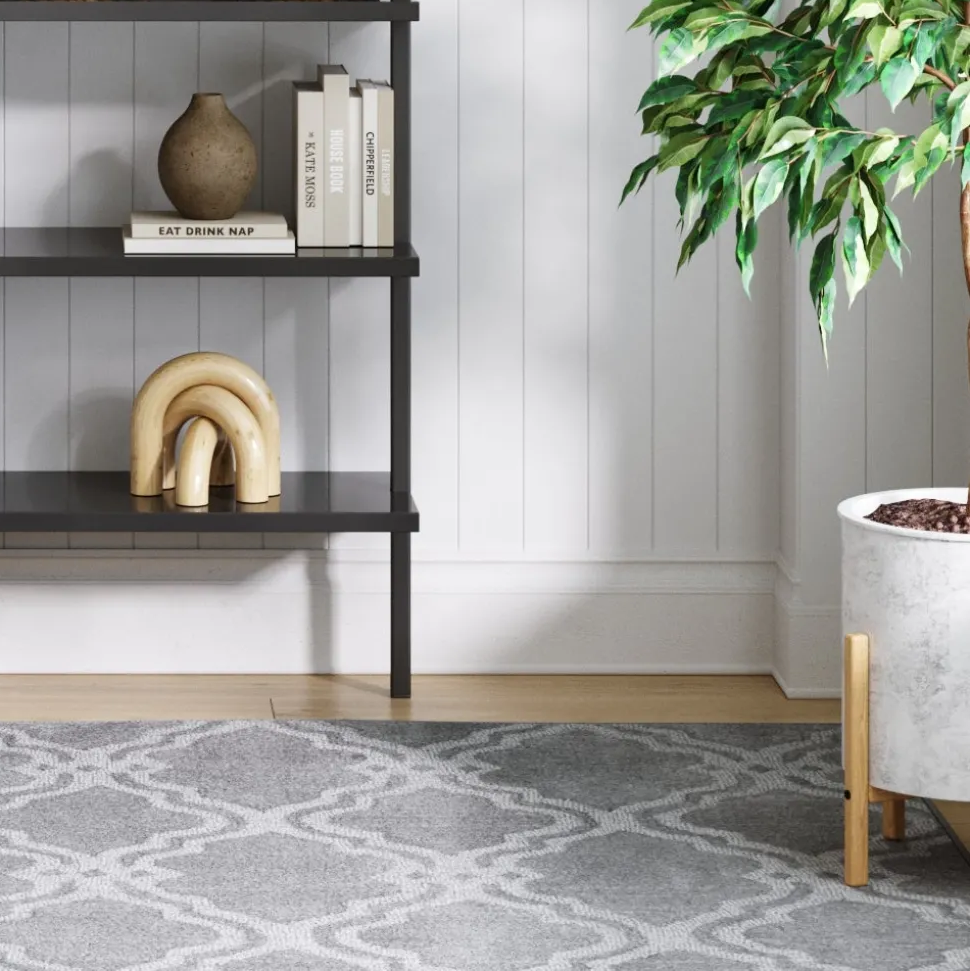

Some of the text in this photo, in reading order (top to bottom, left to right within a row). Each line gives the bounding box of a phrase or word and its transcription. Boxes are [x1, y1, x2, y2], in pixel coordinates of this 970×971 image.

[305, 142, 315, 173] KATE
[330, 130, 344, 193] HOUSE BOOK
[366, 132, 374, 196] CHIPPERFIELD
[305, 177, 315, 208] MOSS
[159, 227, 254, 236] EAT DRINK NAP
